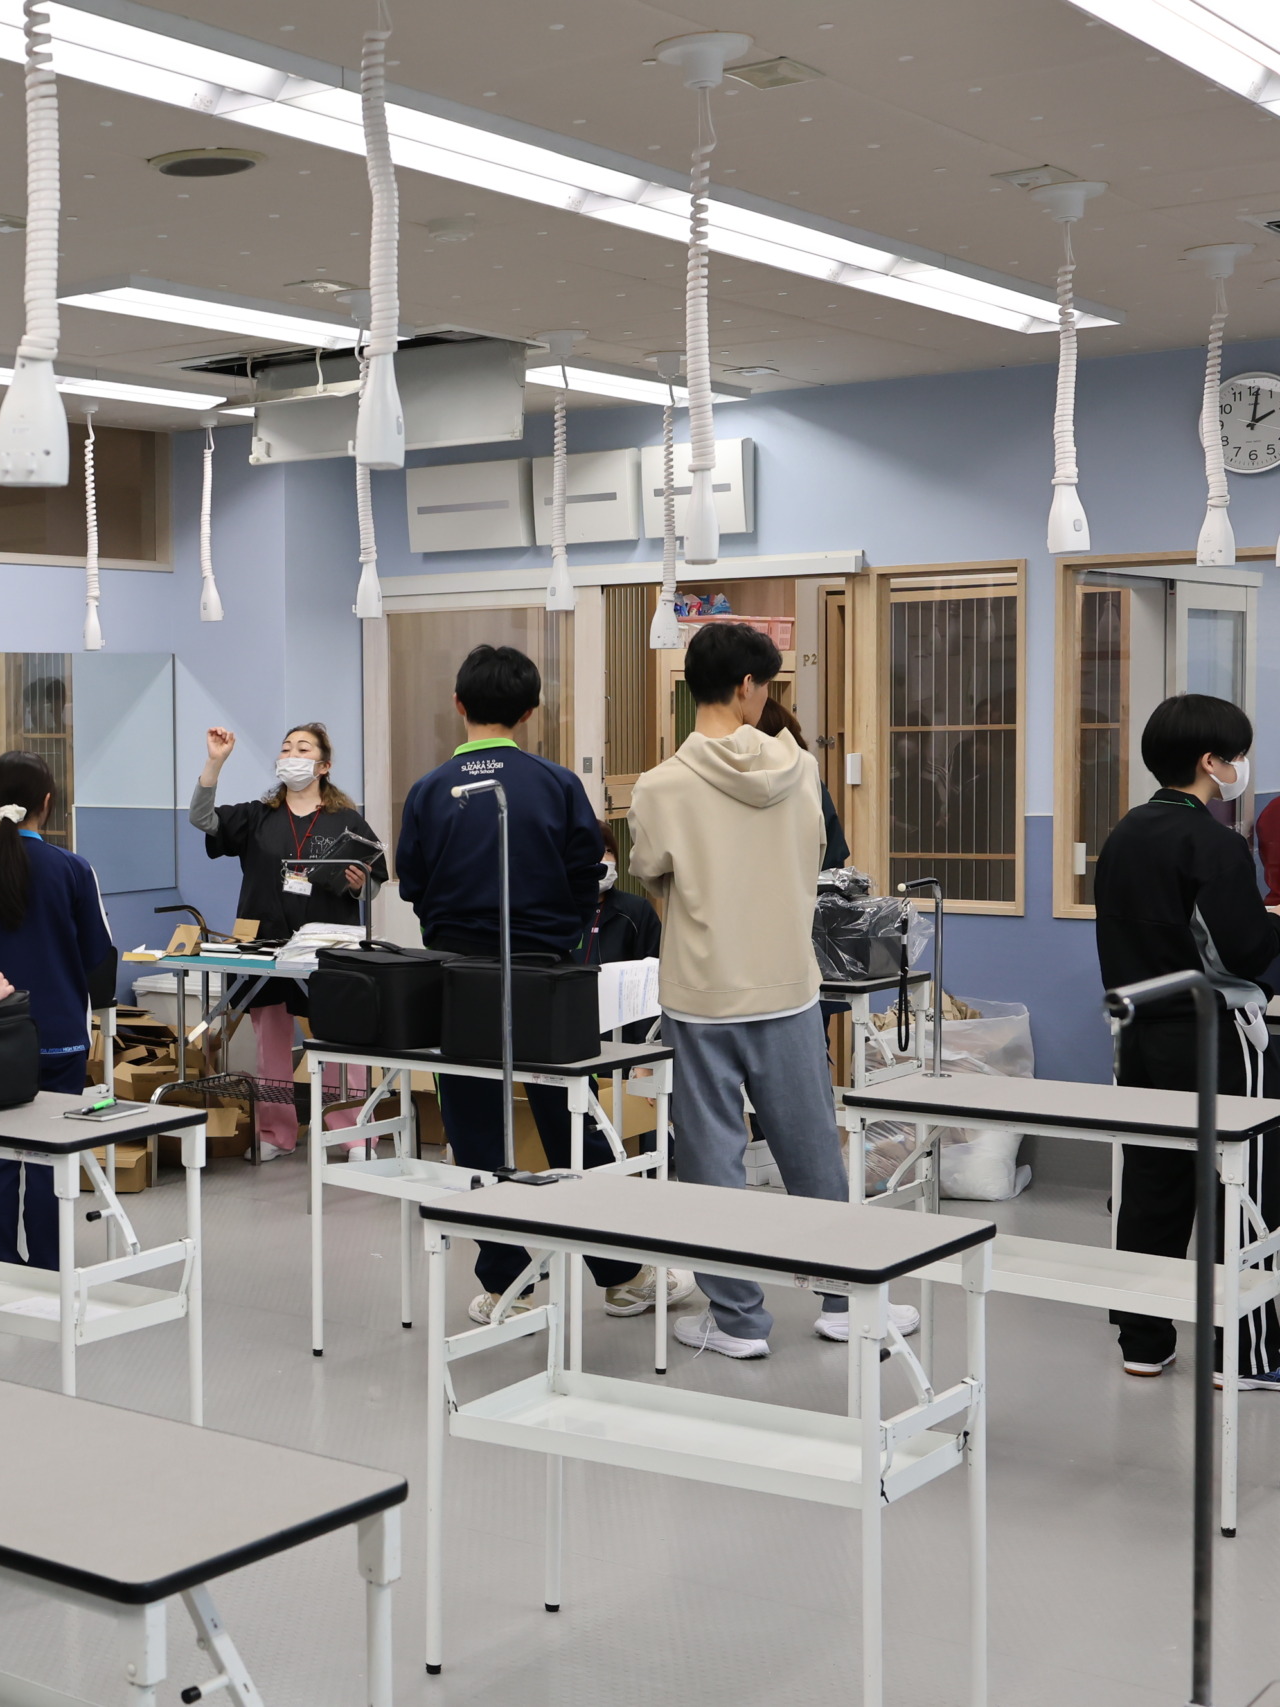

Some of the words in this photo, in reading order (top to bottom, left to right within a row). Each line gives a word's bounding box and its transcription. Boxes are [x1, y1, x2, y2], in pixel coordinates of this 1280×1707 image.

[1232, 391, 1242, 402] 11
[1268, 388, 1273, 399] 1
[1219, 403, 1233, 415] 10
[1233, 446, 1242, 458] 7
[1267, 444, 1276, 455] 5
[1249, 450, 1258, 461] 6
[802, 653, 817, 667] P2
[461, 764, 486, 772] SUZAKA
